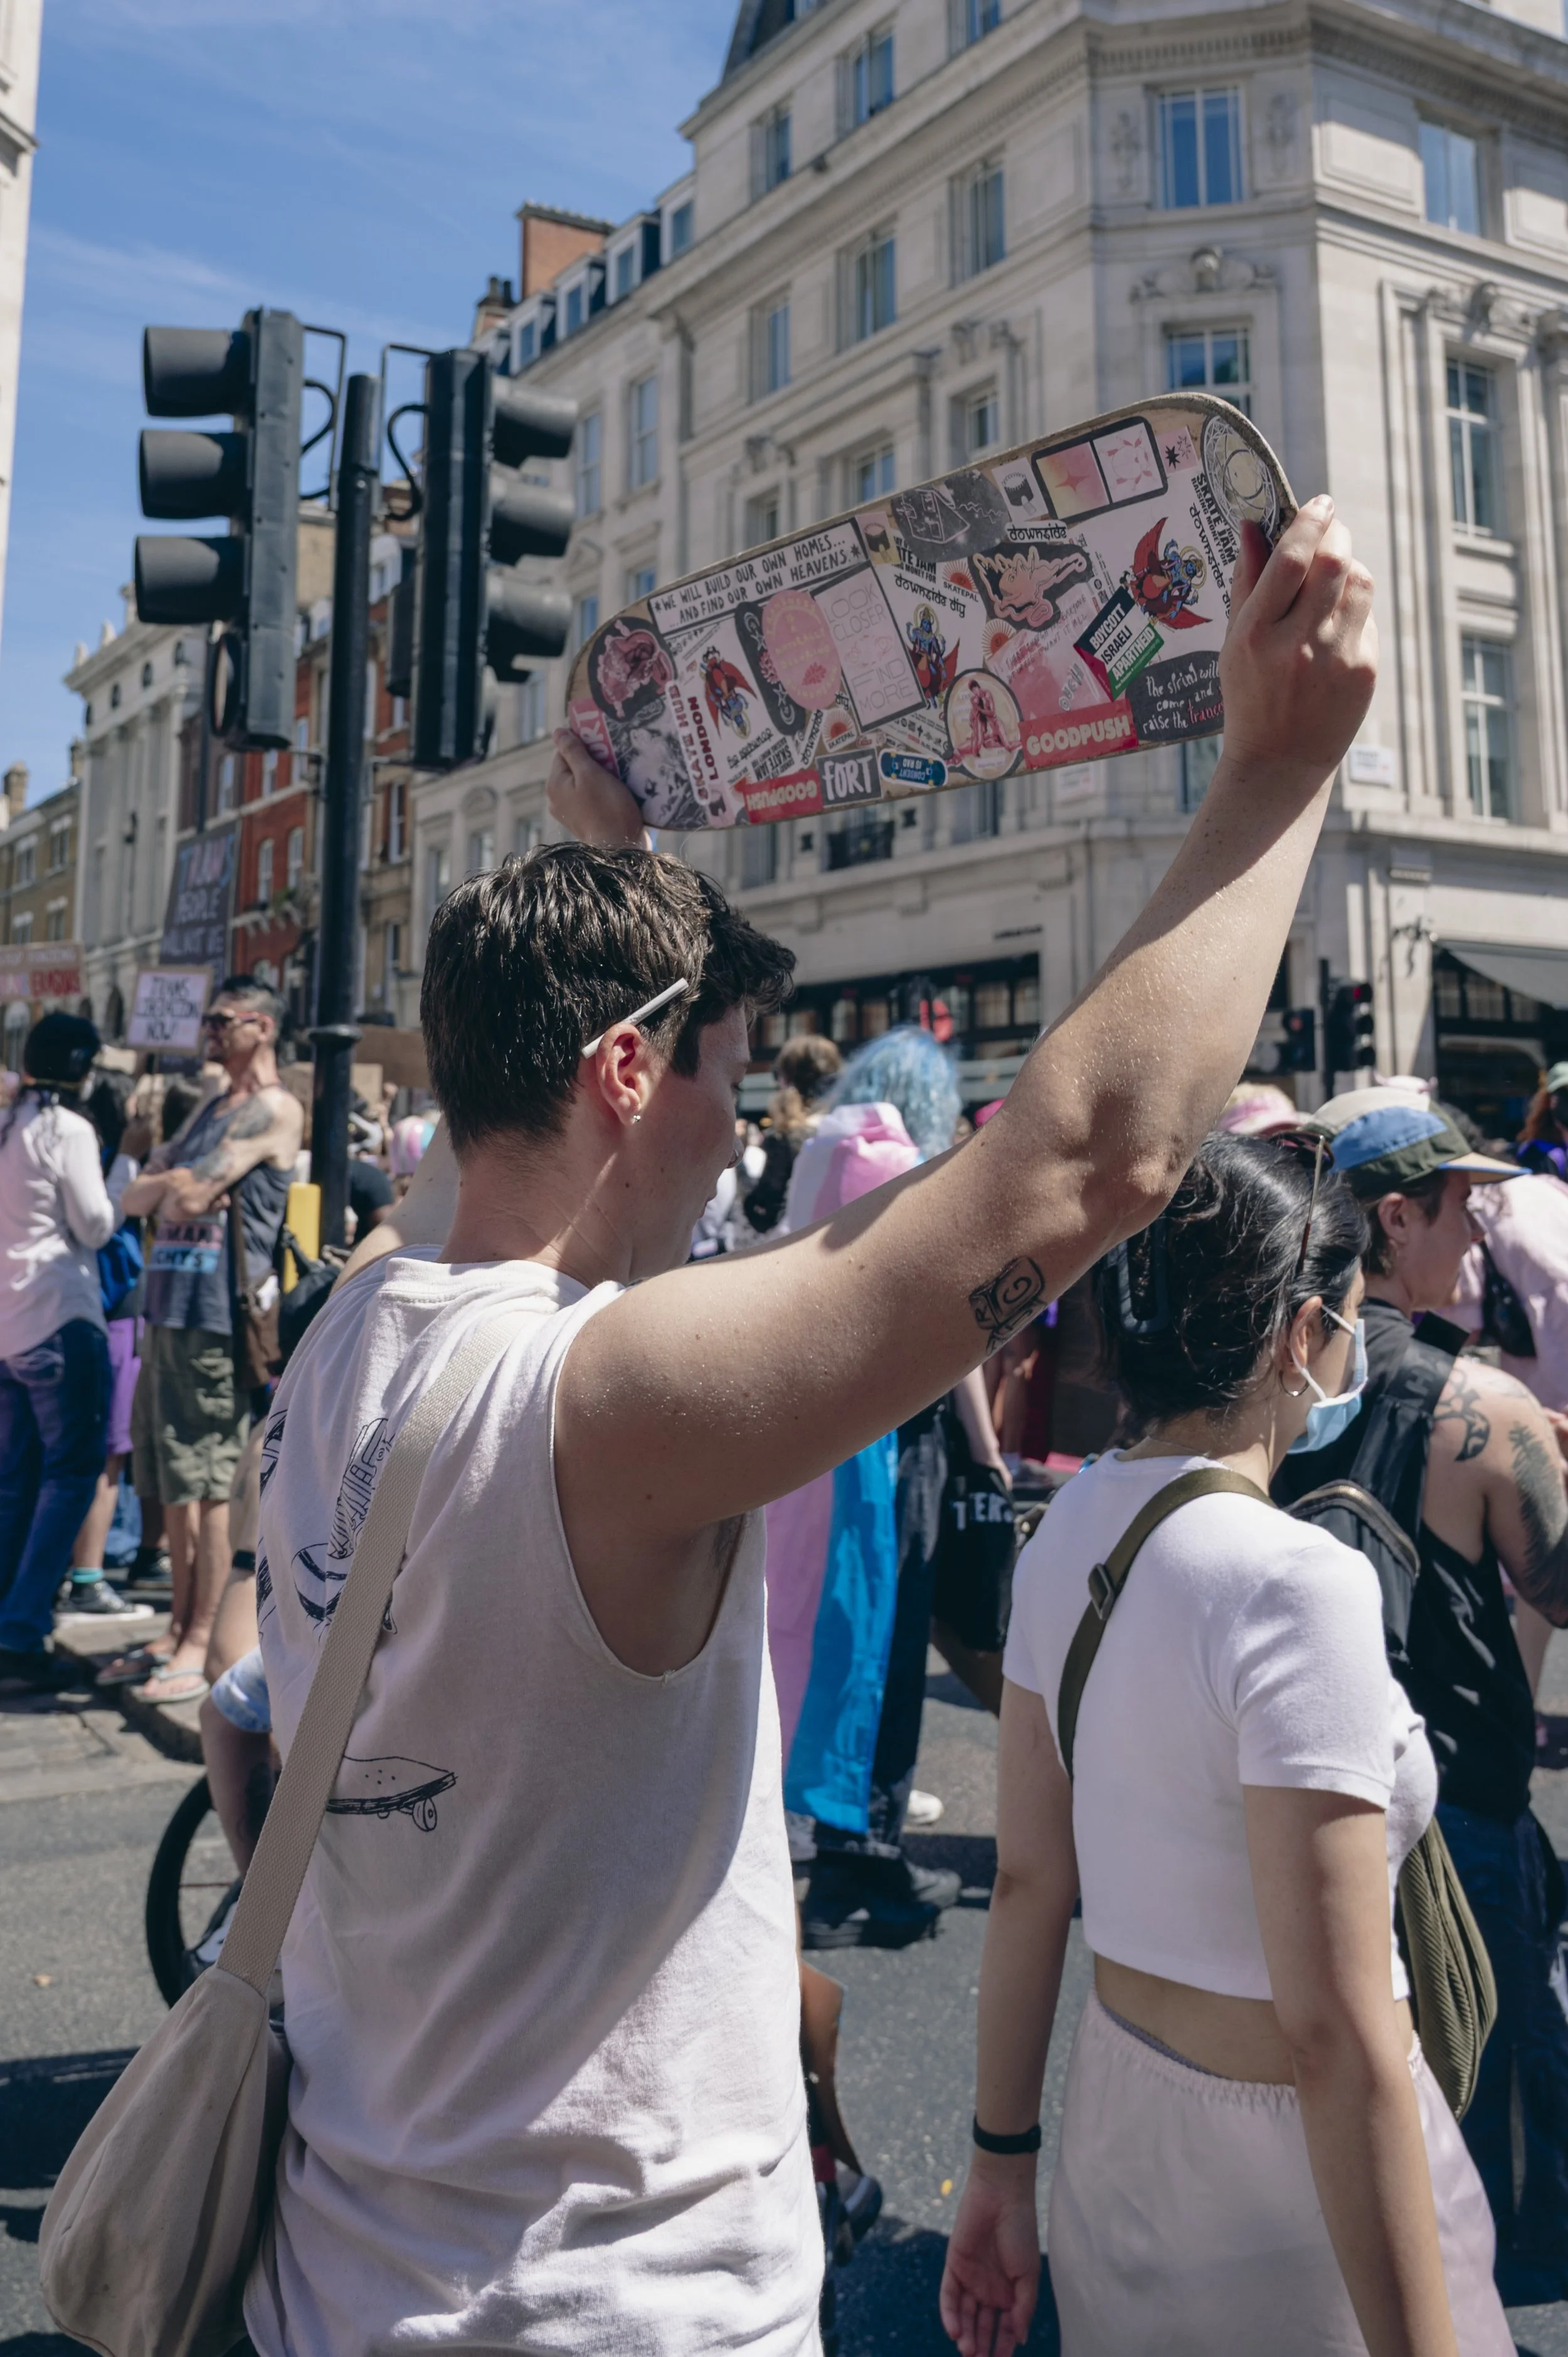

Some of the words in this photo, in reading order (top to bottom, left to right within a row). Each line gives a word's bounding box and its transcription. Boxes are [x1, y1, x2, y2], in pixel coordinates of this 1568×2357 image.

[1007, 523, 1067, 541] downside
[1192, 478, 1209, 516] RAISING
[1206, 516, 1221, 546] MONEY
[1218, 546, 1228, 567] FOR
[1197, 472, 1222, 526] SKATE
[1217, 526, 1236, 563] JAM
[681, 587, 701, 603] WILL
[704, 575, 731, 595] BUILD
[736, 564, 756, 582] OUR
[761, 552, 787, 573] OWN
[905, 563, 924, 579] MONEY
[925, 572, 937, 584] FOR
[943, 581, 978, 602] SKATEPAL
[701, 598, 724, 615] FIND
[728, 587, 748, 604] OUR
[755, 574, 783, 595] OWN
[824, 584, 879, 624] LOOK
[833, 604, 887, 642] CLOSER
[1089, 602, 1126, 651] BOYCOTT
[1101, 625, 1133, 665] ISRAELI
[1111, 627, 1155, 681] APARTHEID
[851, 658, 906, 694] FIND
[1146, 676, 1164, 697] the
[1199, 660, 1219, 679] will
[669, 685, 689, 728] HUB
[859, 677, 914, 712] MORE
[1157, 699, 1185, 711] come
[1195, 681, 1214, 703] and
[687, 696, 719, 780] LONDON
[1027, 715, 1130, 756] GOODPUSH
[1143, 715, 1169, 734] raise
[1172, 711, 1189, 728] the
[768, 745, 792, 773] SKATE
[828, 732, 855, 750] SKATEPAL
[753, 762, 770, 782] JAM
[899, 768, 925, 781] CONSENT
[903, 758, 914, 768] RAD
[914, 760, 923, 769] IS
[746, 780, 817, 811] GOODPUSH
